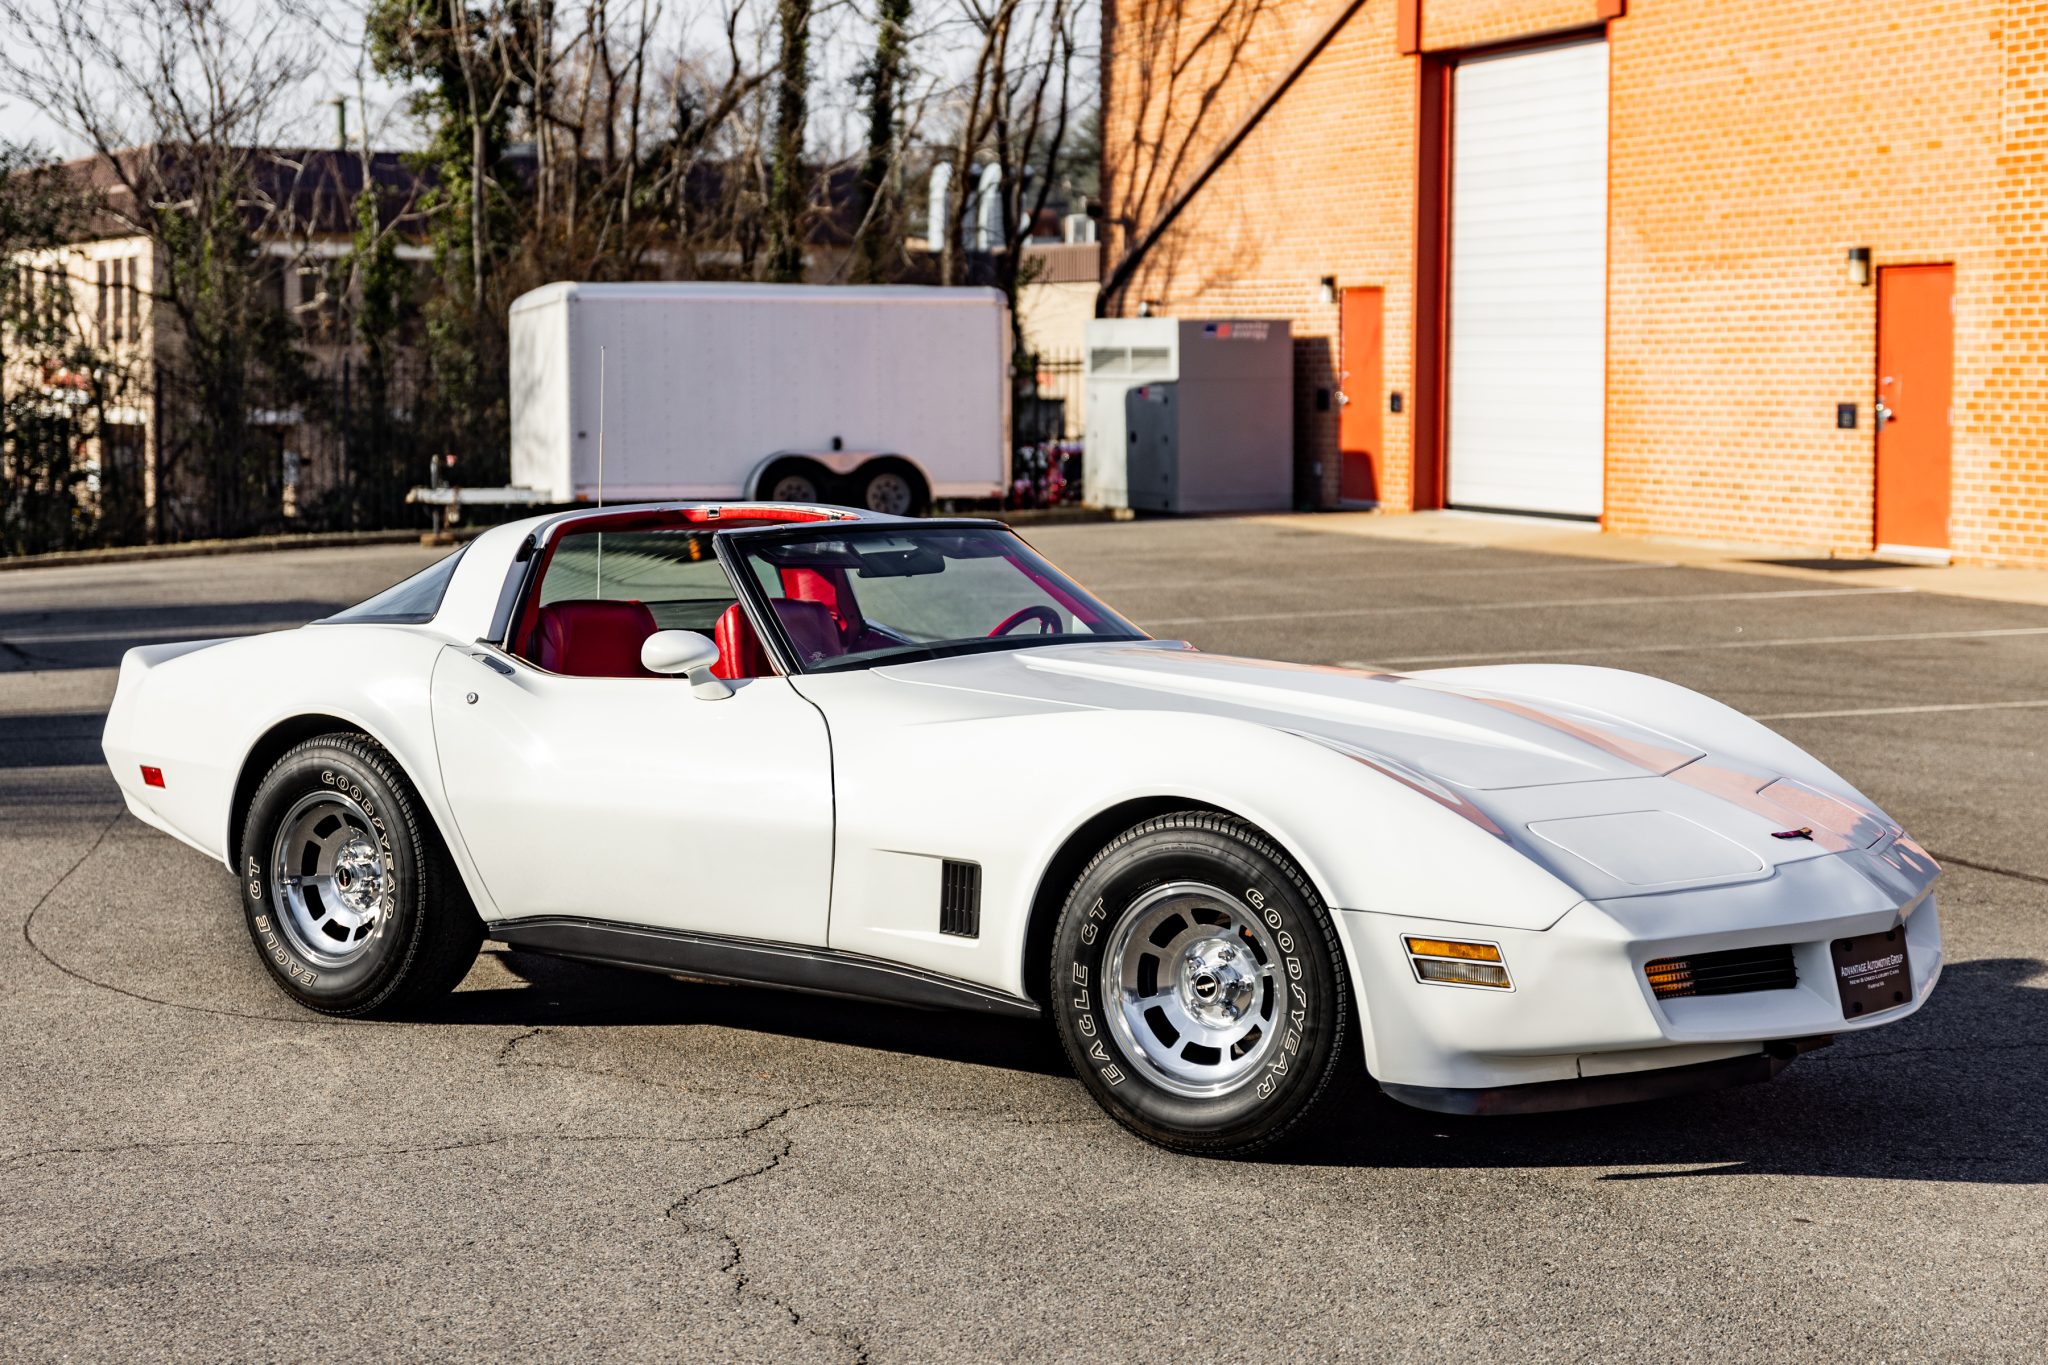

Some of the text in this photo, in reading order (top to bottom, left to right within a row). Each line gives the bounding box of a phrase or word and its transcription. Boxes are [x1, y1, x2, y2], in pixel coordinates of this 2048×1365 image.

[249, 856, 318, 988] EAGLE GT
[321, 770, 396, 919] GOODYEAR
[1073, 897, 1127, 1086] EAGLE GT
[1246, 888, 1306, 1099] GOODYEAR
